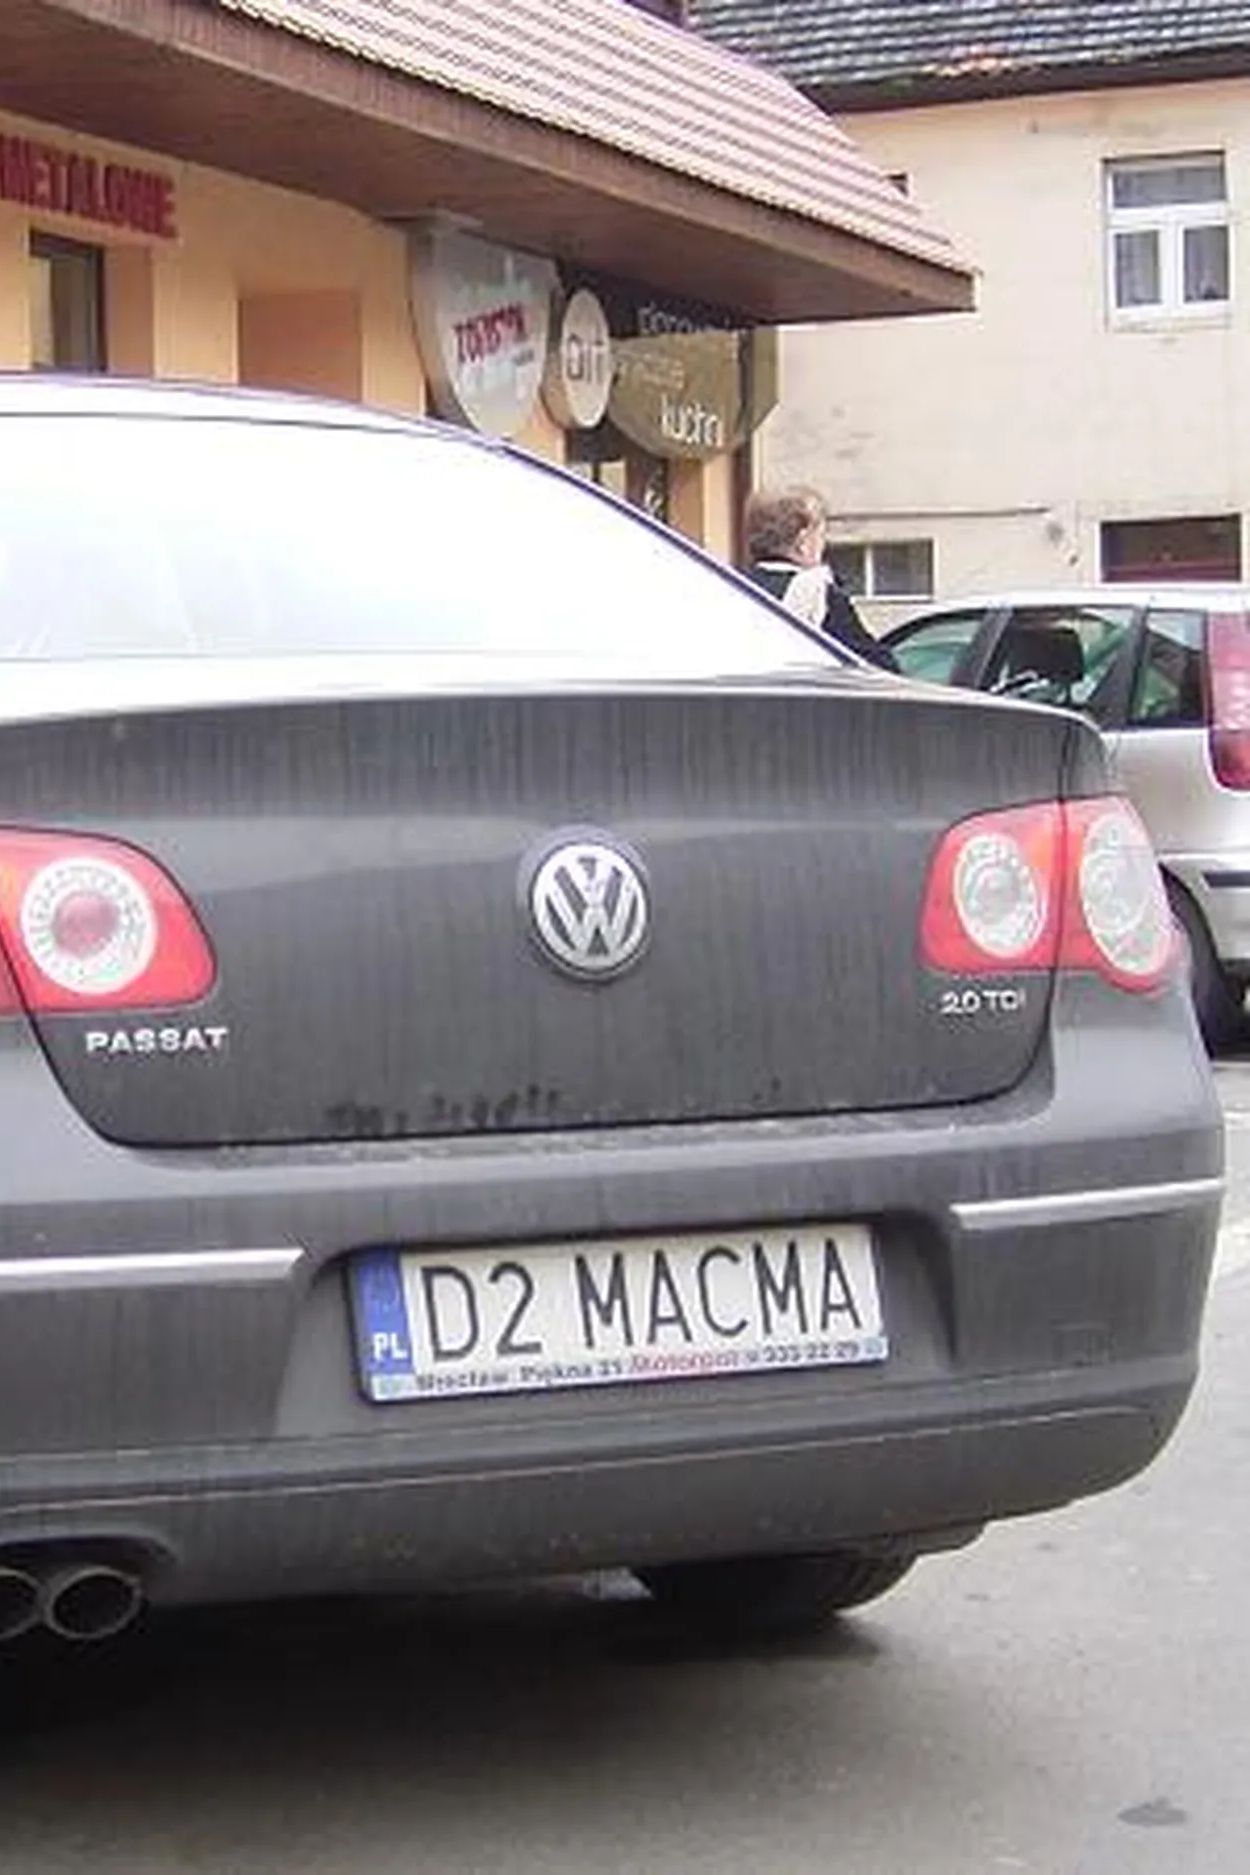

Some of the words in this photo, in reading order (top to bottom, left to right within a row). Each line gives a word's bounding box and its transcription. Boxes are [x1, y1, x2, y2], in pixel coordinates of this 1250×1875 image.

[982, 988, 1026, 1011] TDI
[85, 1027, 229, 1054] PASSAT
[421, 1262, 542, 1362] D2
[574, 1238, 862, 1348] MACMA
[373, 1335, 408, 1361] PL
